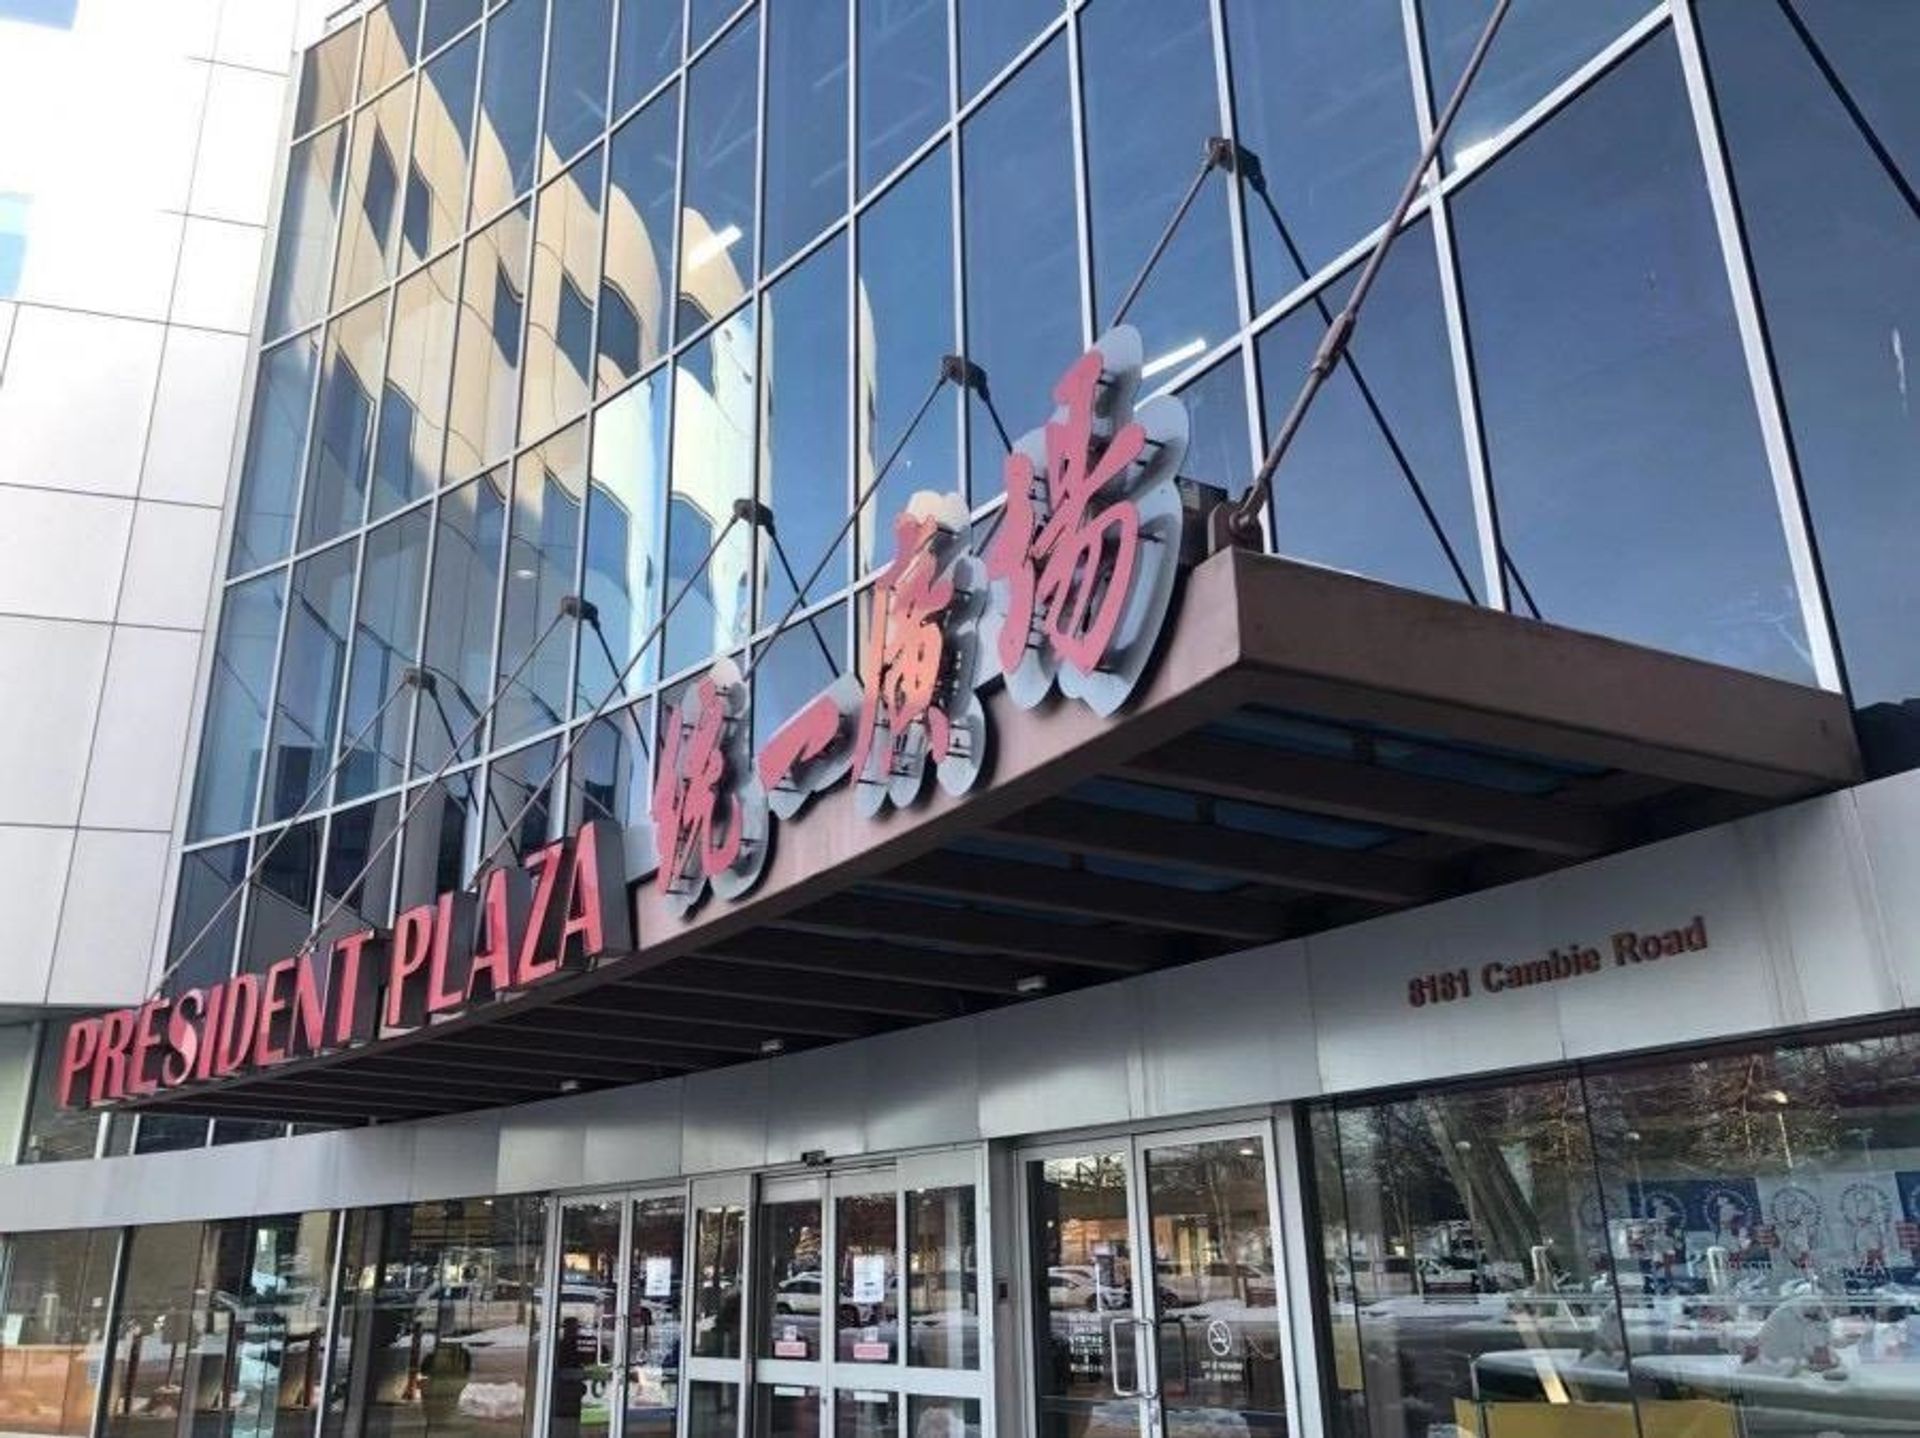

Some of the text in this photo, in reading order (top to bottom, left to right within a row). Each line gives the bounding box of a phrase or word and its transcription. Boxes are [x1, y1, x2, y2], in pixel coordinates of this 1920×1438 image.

[58, 822, 604, 1109] PRESIDENT PLAZA
[1407, 914, 1709, 1008] 8181 Cambie Road
